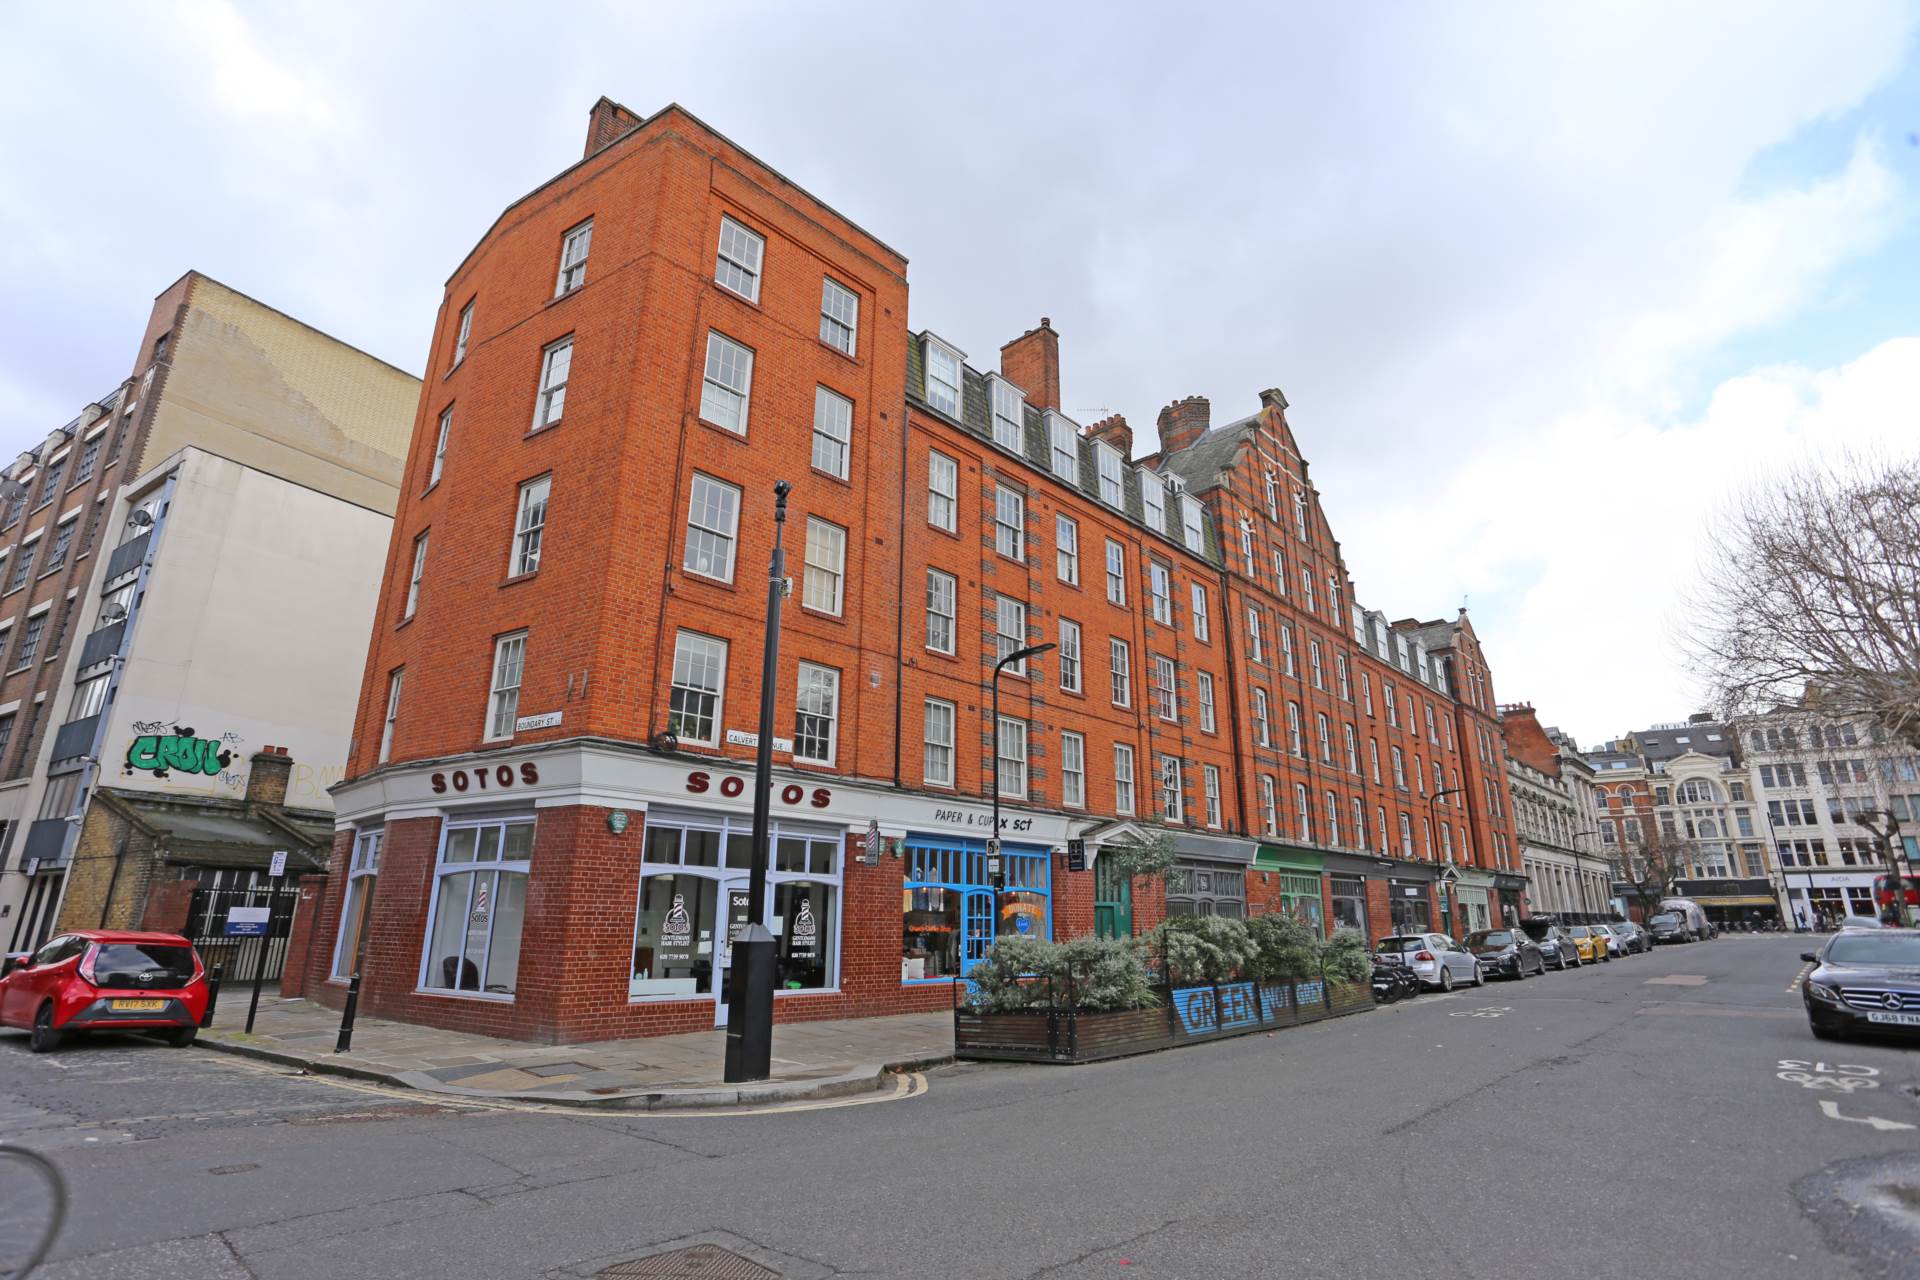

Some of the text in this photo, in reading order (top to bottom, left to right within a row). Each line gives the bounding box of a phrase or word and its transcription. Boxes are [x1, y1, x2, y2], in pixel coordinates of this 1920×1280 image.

[518, 719, 544, 730] BOUNDARY
[729, 734, 757, 745] CALVERT
[431, 762, 539, 794] SOTOS
[686, 771, 832, 809] SOOS
[935, 809, 963, 823] PAPER
[967, 813, 973, 824] &
[978, 814, 994, 827] CUP
[1187, 987, 1260, 1029] GREEN
[1296, 980, 1323, 1005] GREY
